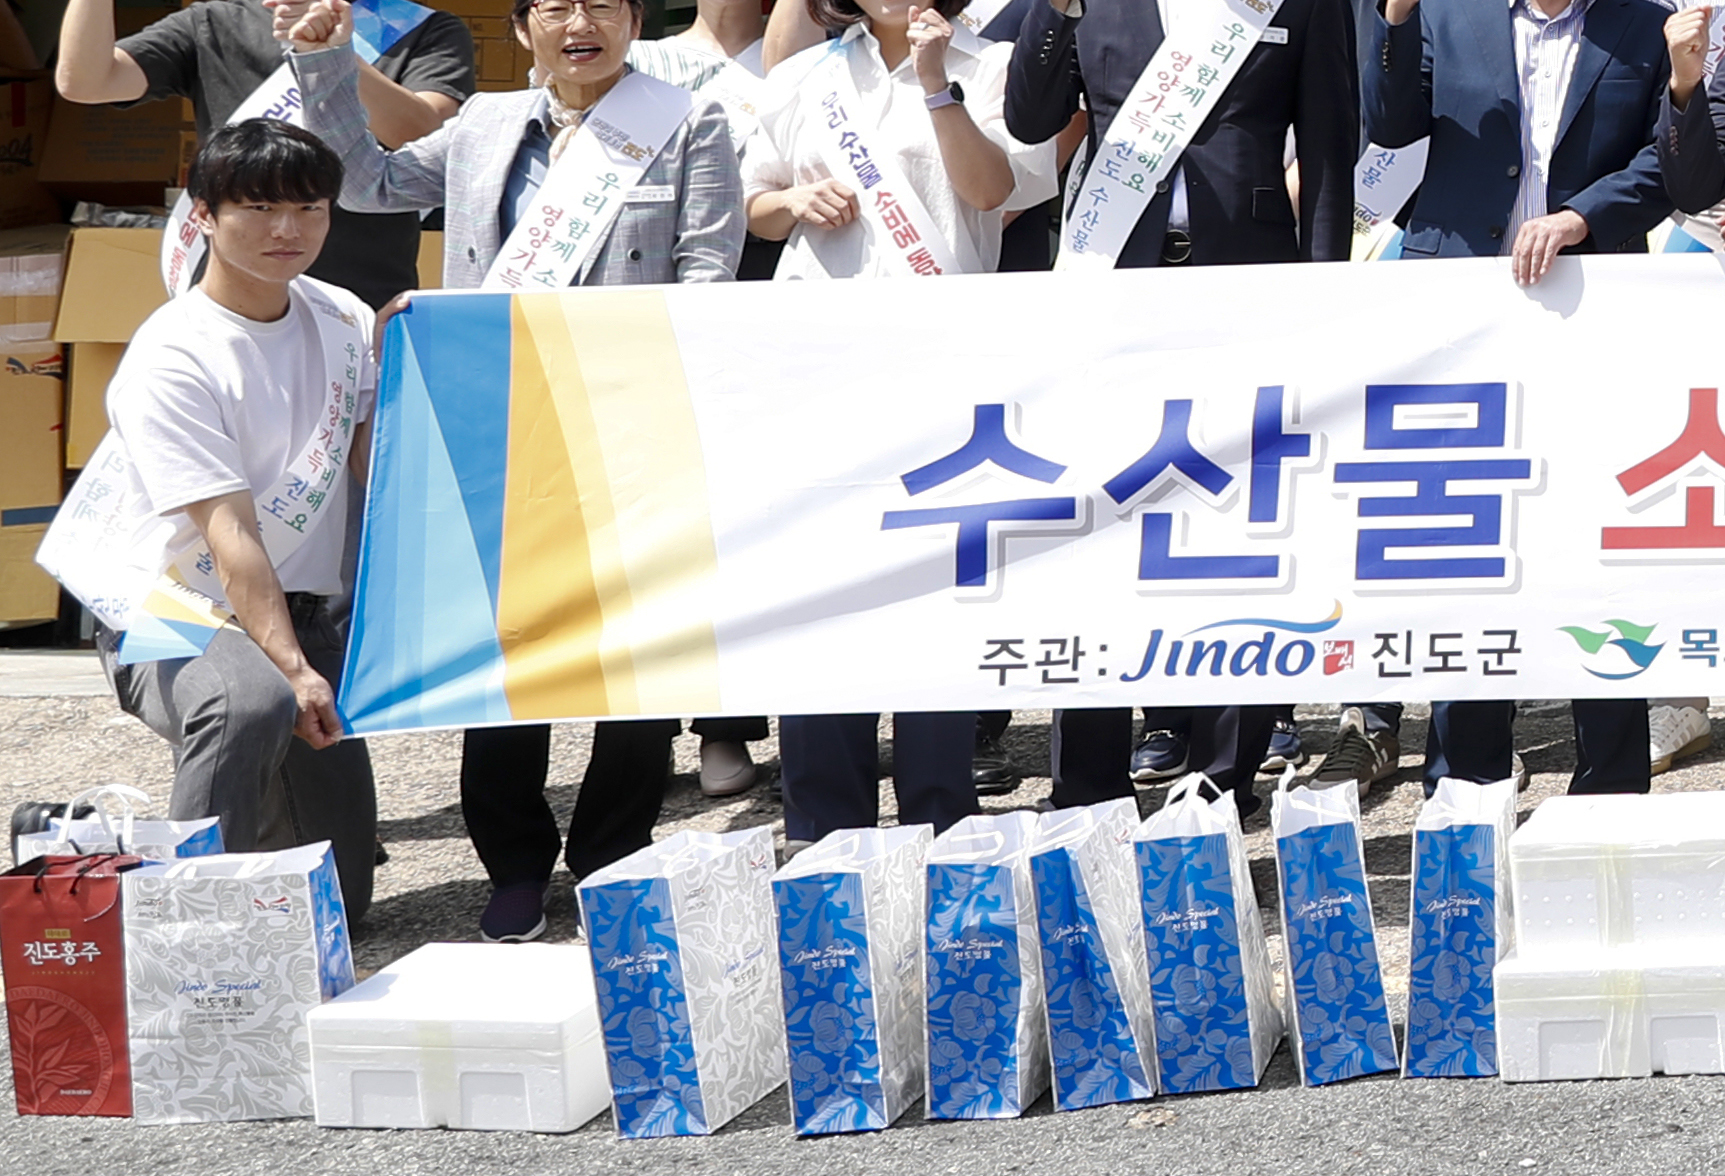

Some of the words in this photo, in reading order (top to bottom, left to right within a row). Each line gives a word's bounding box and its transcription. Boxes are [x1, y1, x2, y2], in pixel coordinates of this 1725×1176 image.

[1210, 21, 1248, 65] 우리
[1128, 50, 1194, 135] 영양가득
[1179, 63, 1220, 109] 함께
[821, 90, 849, 130] 우리
[838, 131, 883, 190] 수산물
[874, 189, 922, 249] 소비에
[1098, 138, 1136, 183] 진도
[1121, 110, 1187, 195] 소비해요
[581, 172, 621, 216] 우리
[550, 217, 591, 264] 함께
[1071, 186, 1109, 254] 수산물
[261, 475, 309, 520] 진도
[879, 380, 1533, 588] 수산물
[1118, 627, 1316, 684] Jindo
[1370, 627, 1523, 679] 진도군
[22, 940, 102, 966] 진도홍주
